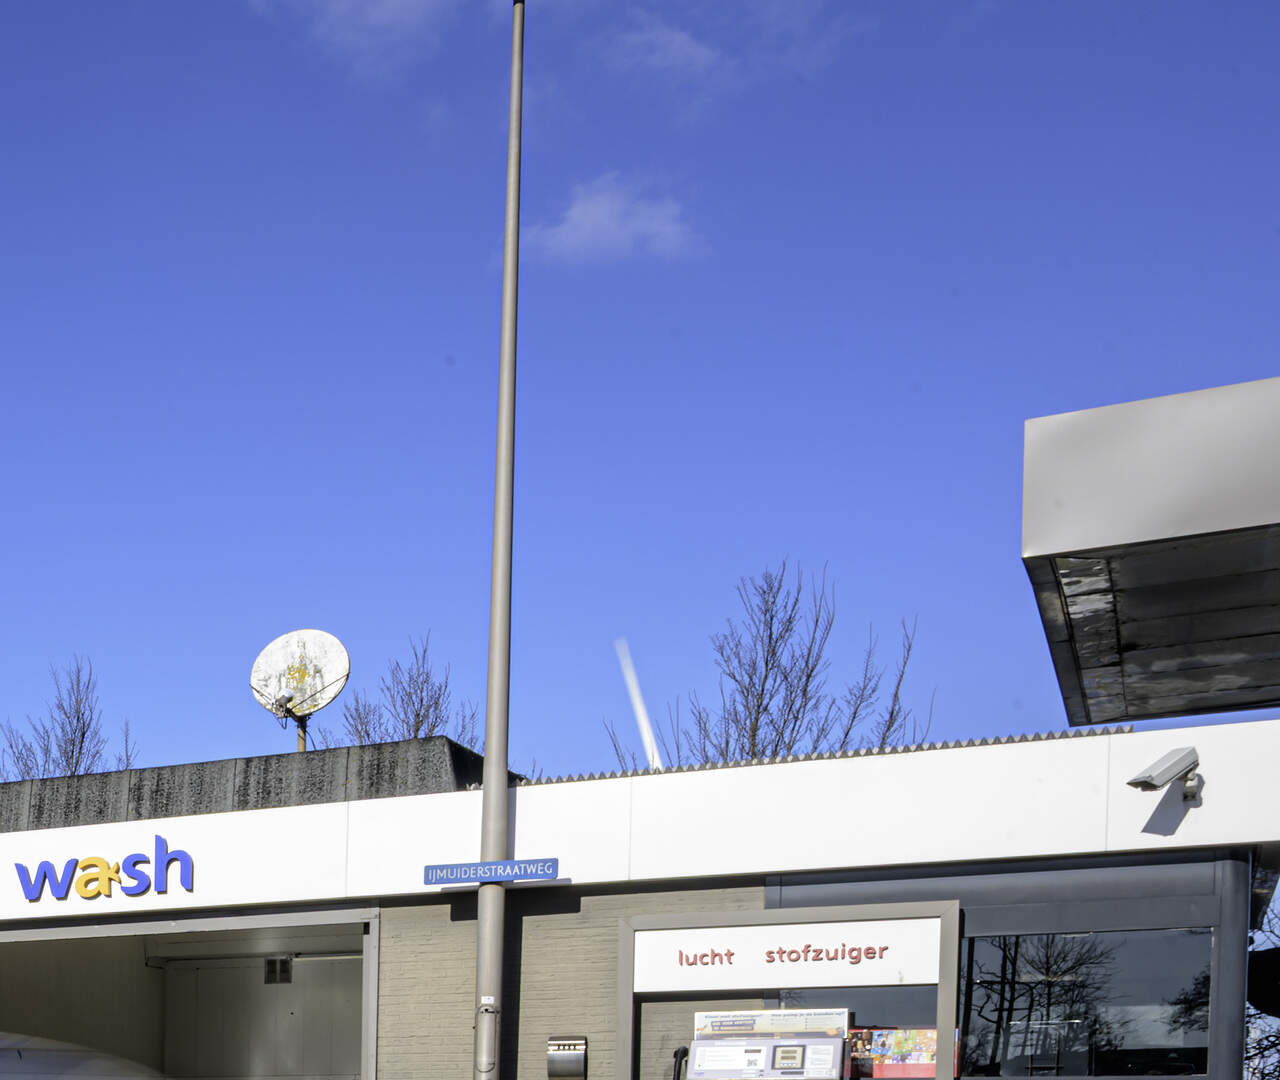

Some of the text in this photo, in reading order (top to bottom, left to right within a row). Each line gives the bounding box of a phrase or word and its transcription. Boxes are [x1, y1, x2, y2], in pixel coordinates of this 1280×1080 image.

[14, 834, 195, 903] wash
[428, 862, 553, 883] IJMUIDERSTRAATWEG
[678, 942, 889, 967] lucht stofzuiger
